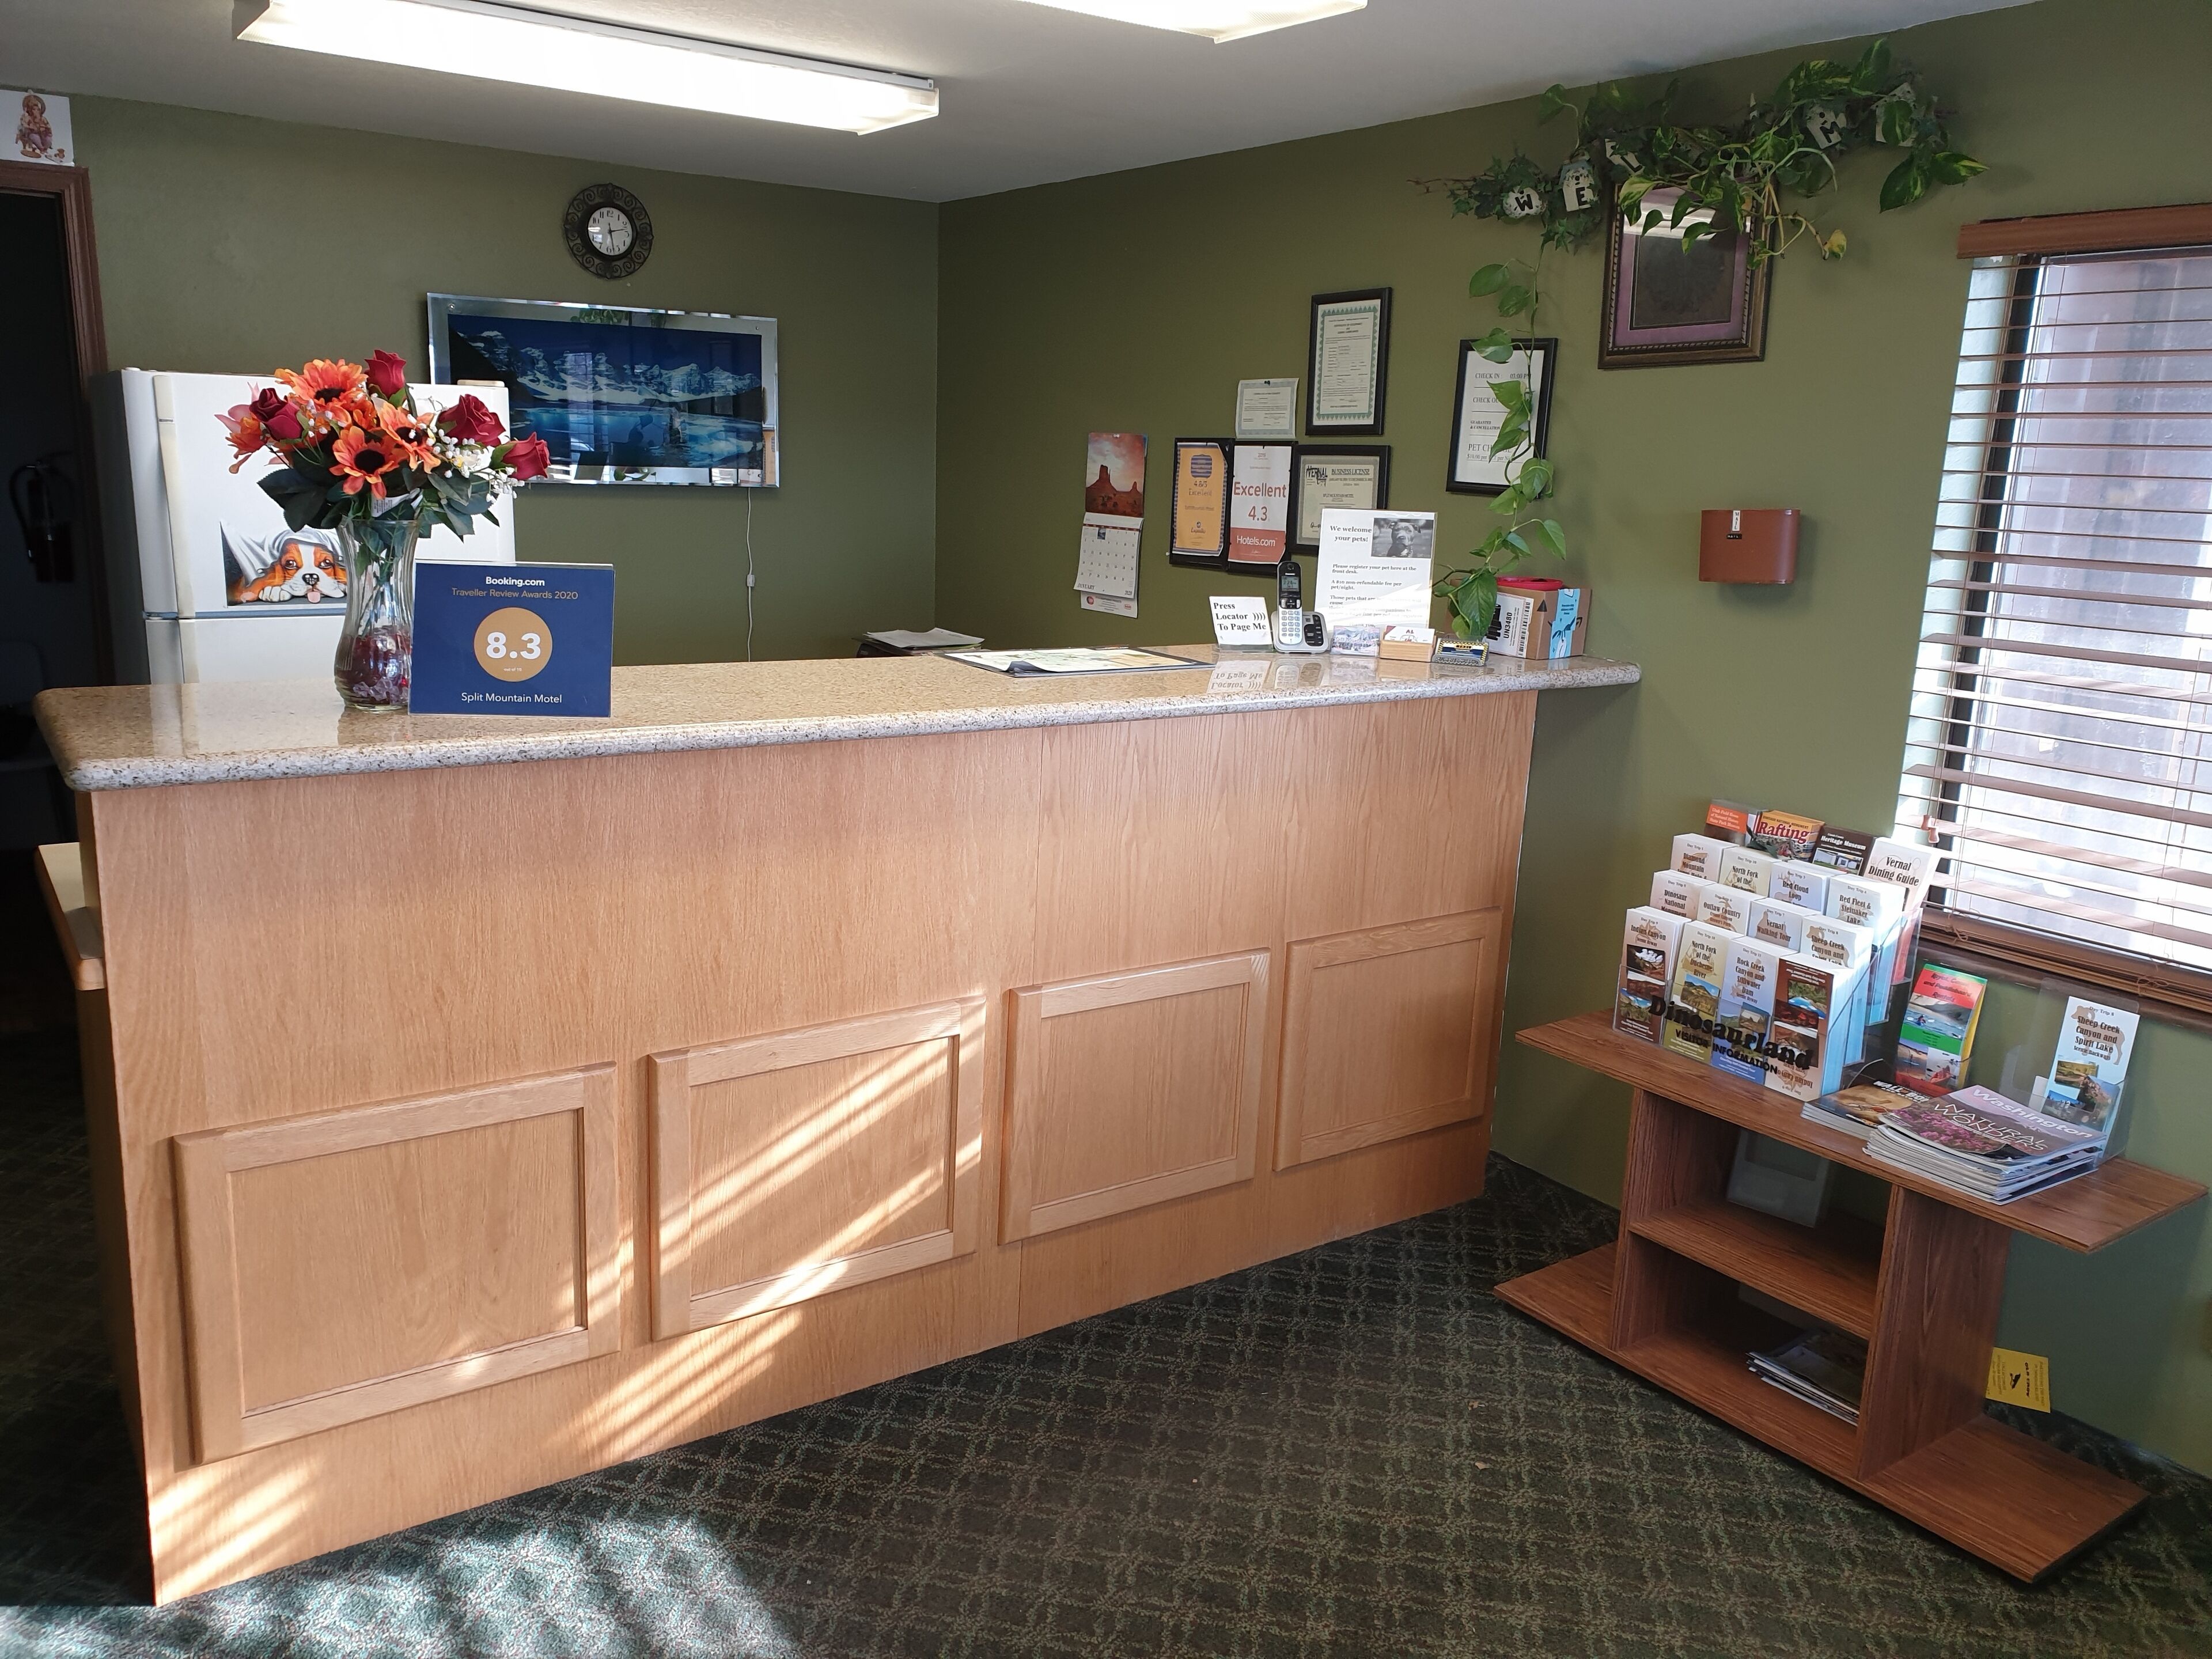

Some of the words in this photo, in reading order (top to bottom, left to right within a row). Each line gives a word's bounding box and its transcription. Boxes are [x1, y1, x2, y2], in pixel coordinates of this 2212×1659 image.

[1515, 194, 1533, 211] W
[1575, 187, 1588, 206] E
[1233, 482, 1287, 498] Excellent
[1248, 505, 1267, 521] 4.3
[1236, 535, 1276, 547] Hotels.com
[486, 576, 545, 587] Booking.com
[452, 588, 487, 597] Traveller
[490, 589, 519, 598] Review
[521, 590, 552, 599] Awards
[555, 591, 578, 600] 2020
[1215, 612, 1248, 620] Locator
[1231, 623, 1251, 632] Page
[1503, 612, 1513, 639] UN3480
[486, 631, 541, 660] 8.3
[461, 692, 483, 703] Split
[486, 693, 532, 703] Mountain
[534, 694, 562, 703] Motel
[1759, 821, 1811, 844] Rafting
[1820, 835, 1843, 846] Heritage
[1844, 840, 1866, 850] Museum
[1683, 853, 1705, 864] Diamond
[1885, 857, 1912, 872] Vernal
[1682, 861, 1705, 873] Mountain
[1732, 865, 1746, 876] North
[1747, 869, 1759, 879] Fork
[1743, 878, 1752, 886] the
[1868, 865, 1894, 881] Dining
[1896, 873, 1919, 887] Guide
[1782, 880, 1793, 889] Red
[1794, 884, 1809, 894] Cloud
[1664, 889, 1687, 902] Dinosaur
[1788, 891, 1802, 901] Loop
[1839, 895, 1851, 904] Red
[1852, 897, 1866, 908] Fleet
[1664, 898, 1685, 910] National
[1703, 902, 1720, 912] Outlaw
[1721, 906, 1741, 919] Country
[1841, 904, 1868, 918] Steinaker
[1766, 919, 1783, 930] Vernal
[1846, 915, 1861, 926] Lake
[1631, 925, 1647, 935] Indian
[1647, 929, 1666, 941] Canyon
[1757, 925, 1778, 939] Walking
[1779, 933, 1791, 942] Tour
[1691, 940, 1705, 950] North
[1706, 945, 1717, 955] Fork
[1811, 935, 1828, 946] Sheep
[1829, 940, 1845, 951] Creek
[1702, 953, 1710, 962] the
[1811, 944, 1832, 957] Canyon
[1833, 951, 1844, 960] and
[1737, 957, 1749, 967] Rock
[1751, 961, 1765, 973] Creek
[1694, 969, 1706, 979] River
[1735, 965, 1753, 978] Canyon
[1754, 973, 1765, 982] and
[1737, 975, 1761, 990] Stillwater
[1741, 986, 1754, 997] Dam
[2100, 1008, 2111, 1016] Trip
[2077, 1015, 2099, 1029] Sheep
[2100, 1021, 2120, 1034] Creek
[1649, 995, 1815, 1070] Dinosaurland
[1675, 1029, 1709, 1048] VISITOR
[2075, 1025, 2102, 1040] Canyon
[2103, 1033, 2118, 1044] and
[2075, 1036, 2094, 1048] Spirit
[2096, 1041, 2113, 1054] Lake
[1713, 1043, 1778, 1075] INFORMATION
[1973, 1088, 2093, 1139] Washington
[1934, 1104, 2048, 1151] WONDERS
[1945, 1104, 2045, 1145] NATURAL
